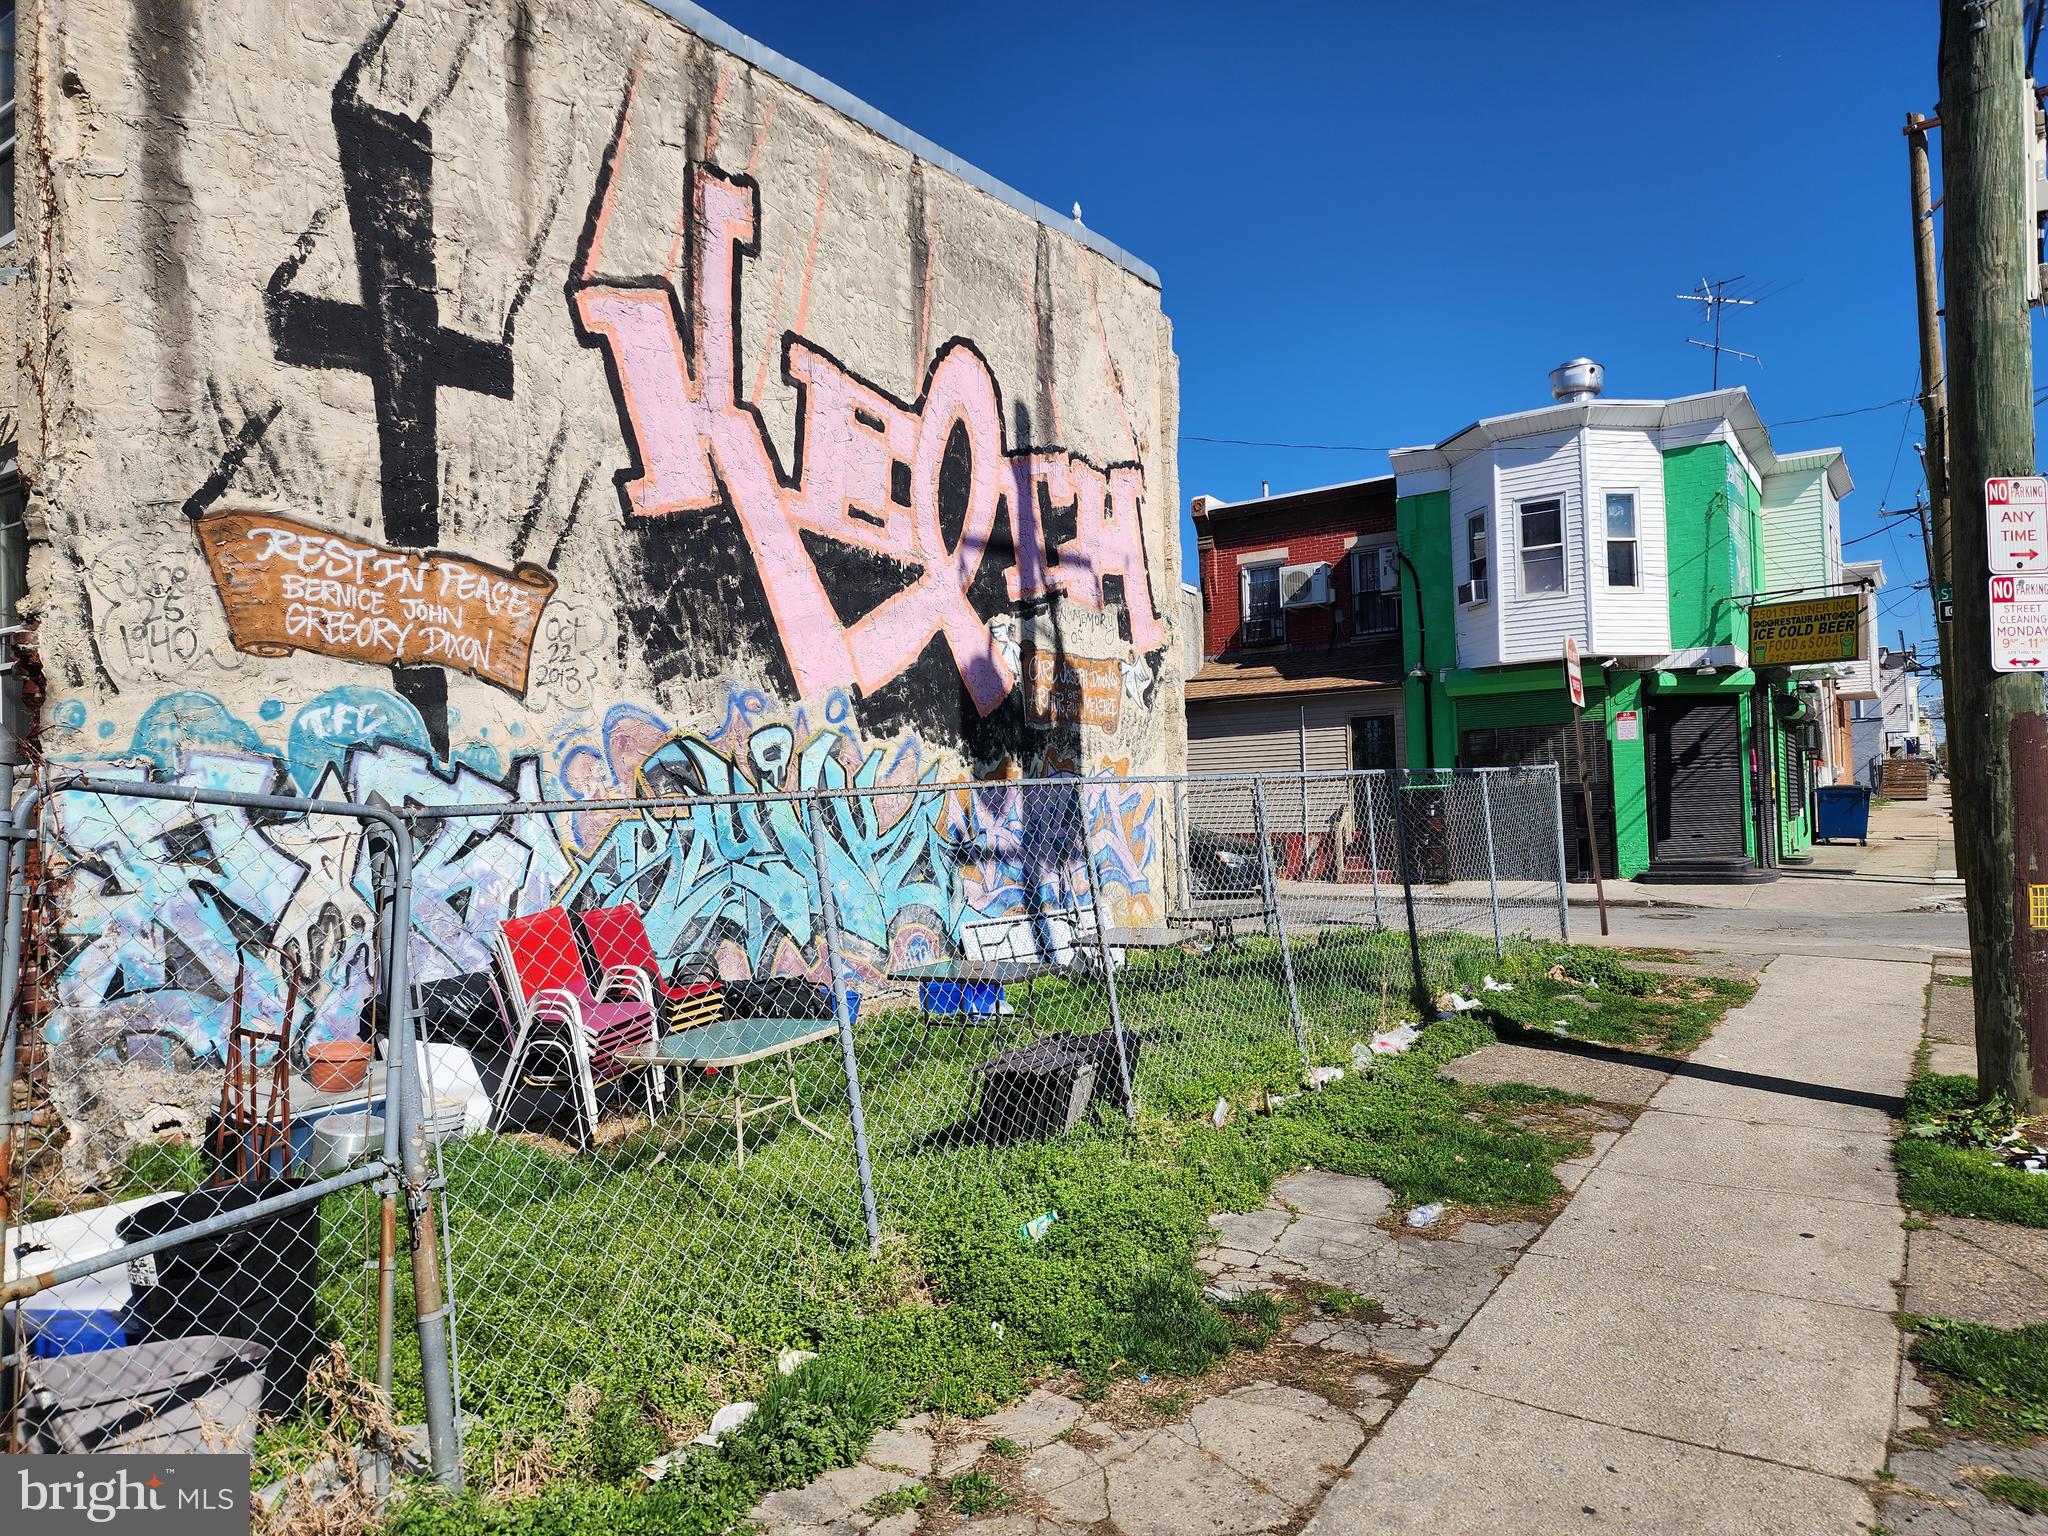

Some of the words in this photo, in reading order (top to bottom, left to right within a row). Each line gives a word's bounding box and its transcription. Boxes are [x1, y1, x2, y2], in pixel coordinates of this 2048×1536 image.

[1989, 483, 2008, 501] NO
[2010, 486, 2043, 498] PARKING
[2001, 511, 2035, 523] ANY
[2001, 530, 2038, 542] TIME
[247, 526, 378, 585] REST
[373, 556, 430, 593] IN
[438, 562, 530, 617] PEACE
[1993, 580, 2013, 599] NO
[137, 595, 185, 626] 25
[281, 574, 386, 615] BERNICE
[399, 598, 463, 630] JOHN
[1753, 608, 1778, 620] 2501
[1779, 602, 1831, 618] STERNER
[1832, 599, 1856, 612] INC.
[2003, 604, 2042, 614] STREET
[1753, 627, 1775, 641] ICE
[1778, 623, 1814, 638] COLD
[1818, 619, 1855, 635] BEER
[1774, 612, 1832, 627] RESTAURANT
[1999, 615, 2048, 624] CLEANING
[119, 624, 198, 667] 1940
[284, 603, 414, 657] GREGORY
[419, 626, 494, 670] DIXON
[1768, 639, 1798, 652] FOOD
[1800, 641, 1807, 650] &
[1808, 635, 1839, 649] SODA
[547, 642, 577, 664] 22
[535, 664, 582, 695] 2013
